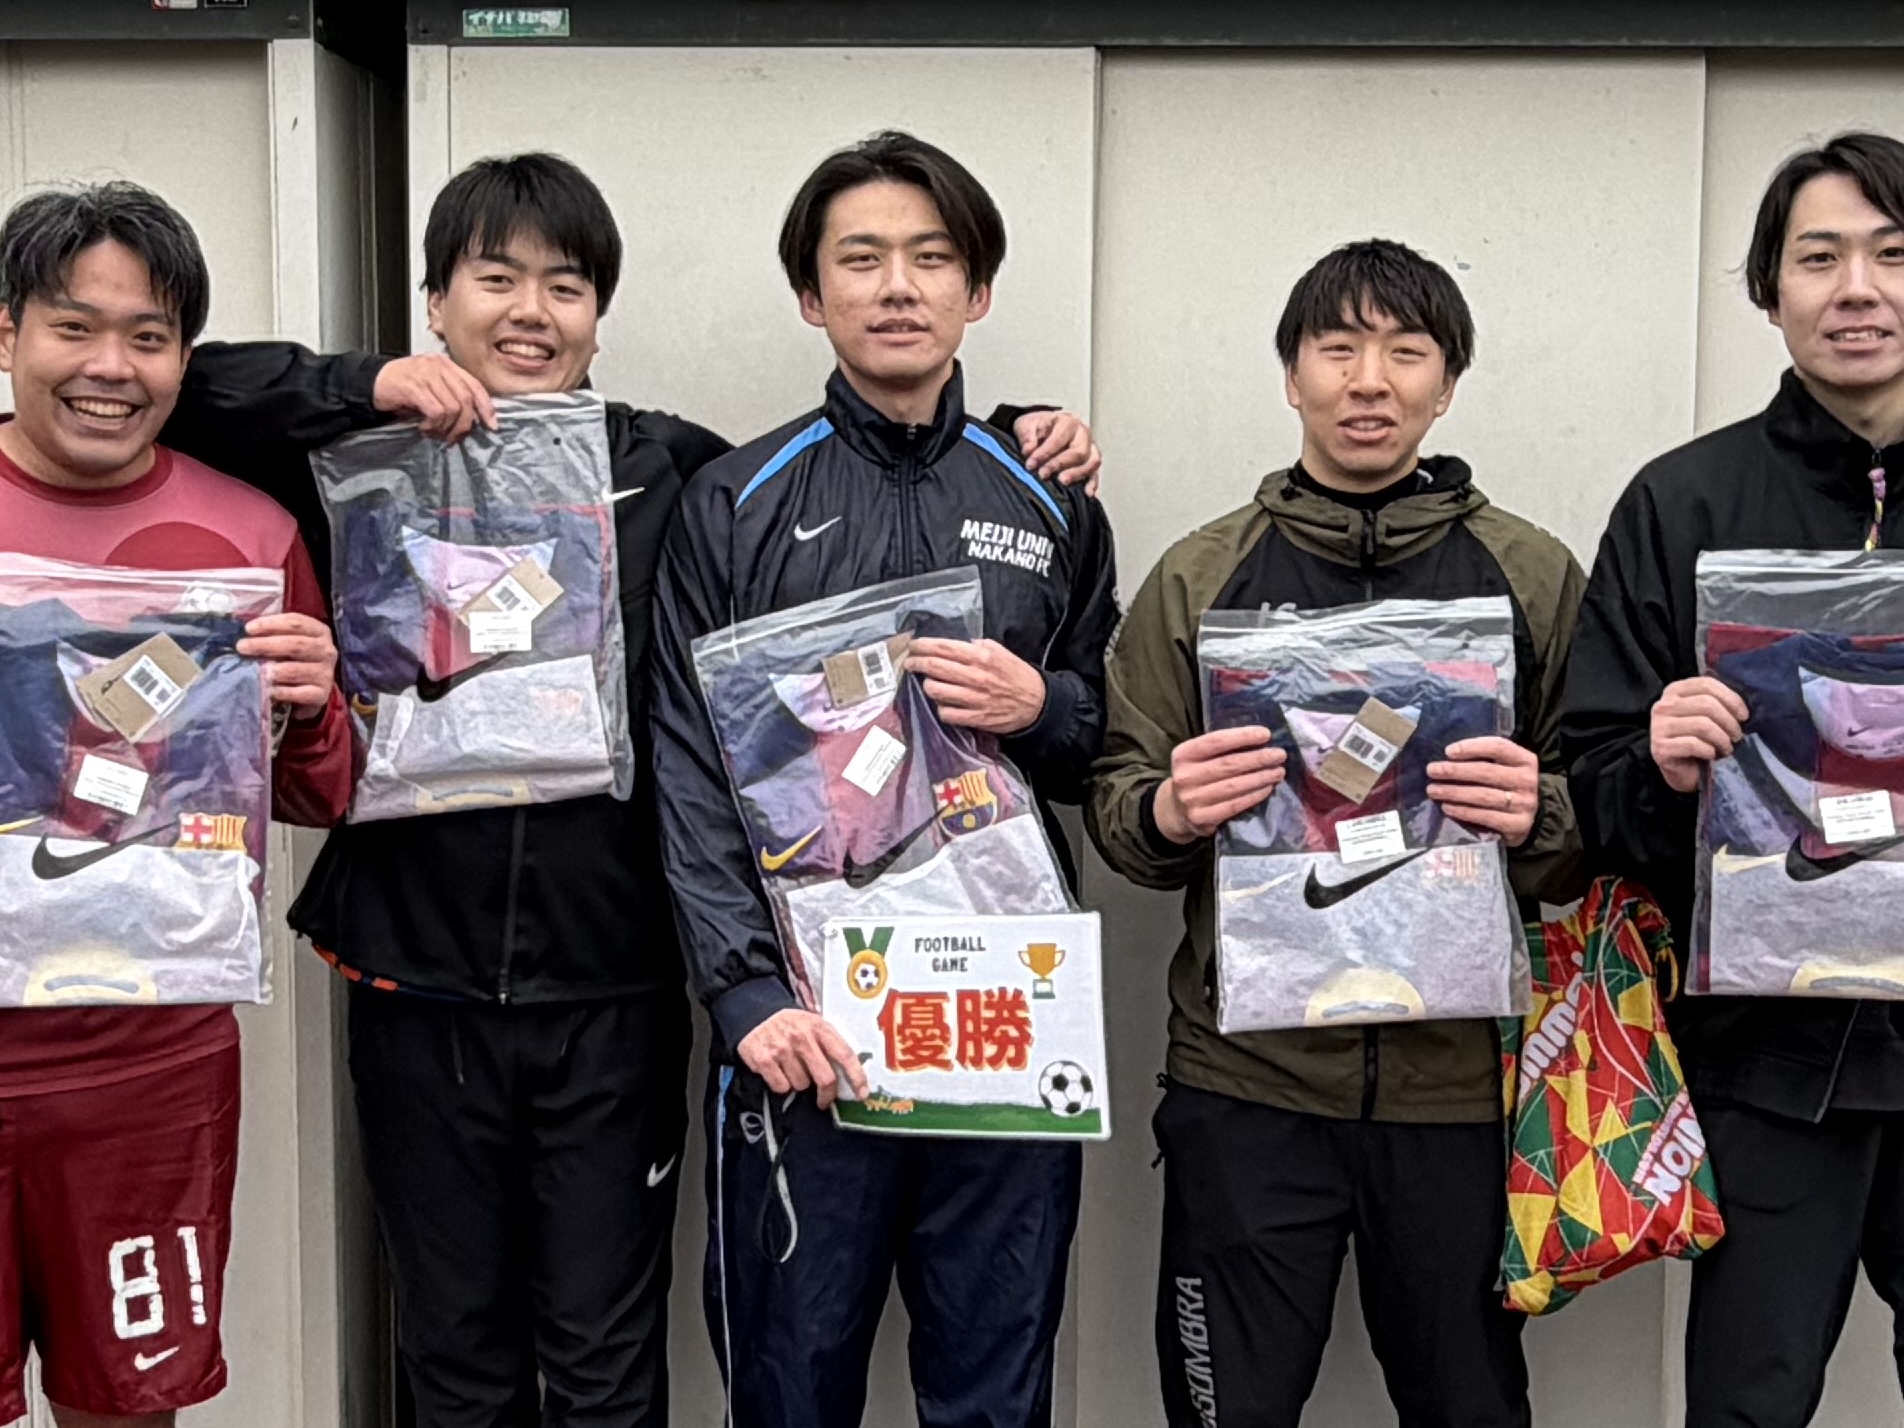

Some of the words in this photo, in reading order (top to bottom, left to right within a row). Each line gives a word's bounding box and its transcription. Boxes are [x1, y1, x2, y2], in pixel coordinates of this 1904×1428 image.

[960, 519, 1014, 546] MEIJI
[968, 540, 1036, 570] NAKANO
[914, 936, 986, 953] FOOTBALL
[932, 957, 968, 972] GAME
[876, 987, 1034, 1072] 優勝
[108, 1226, 207, 1339] 81
